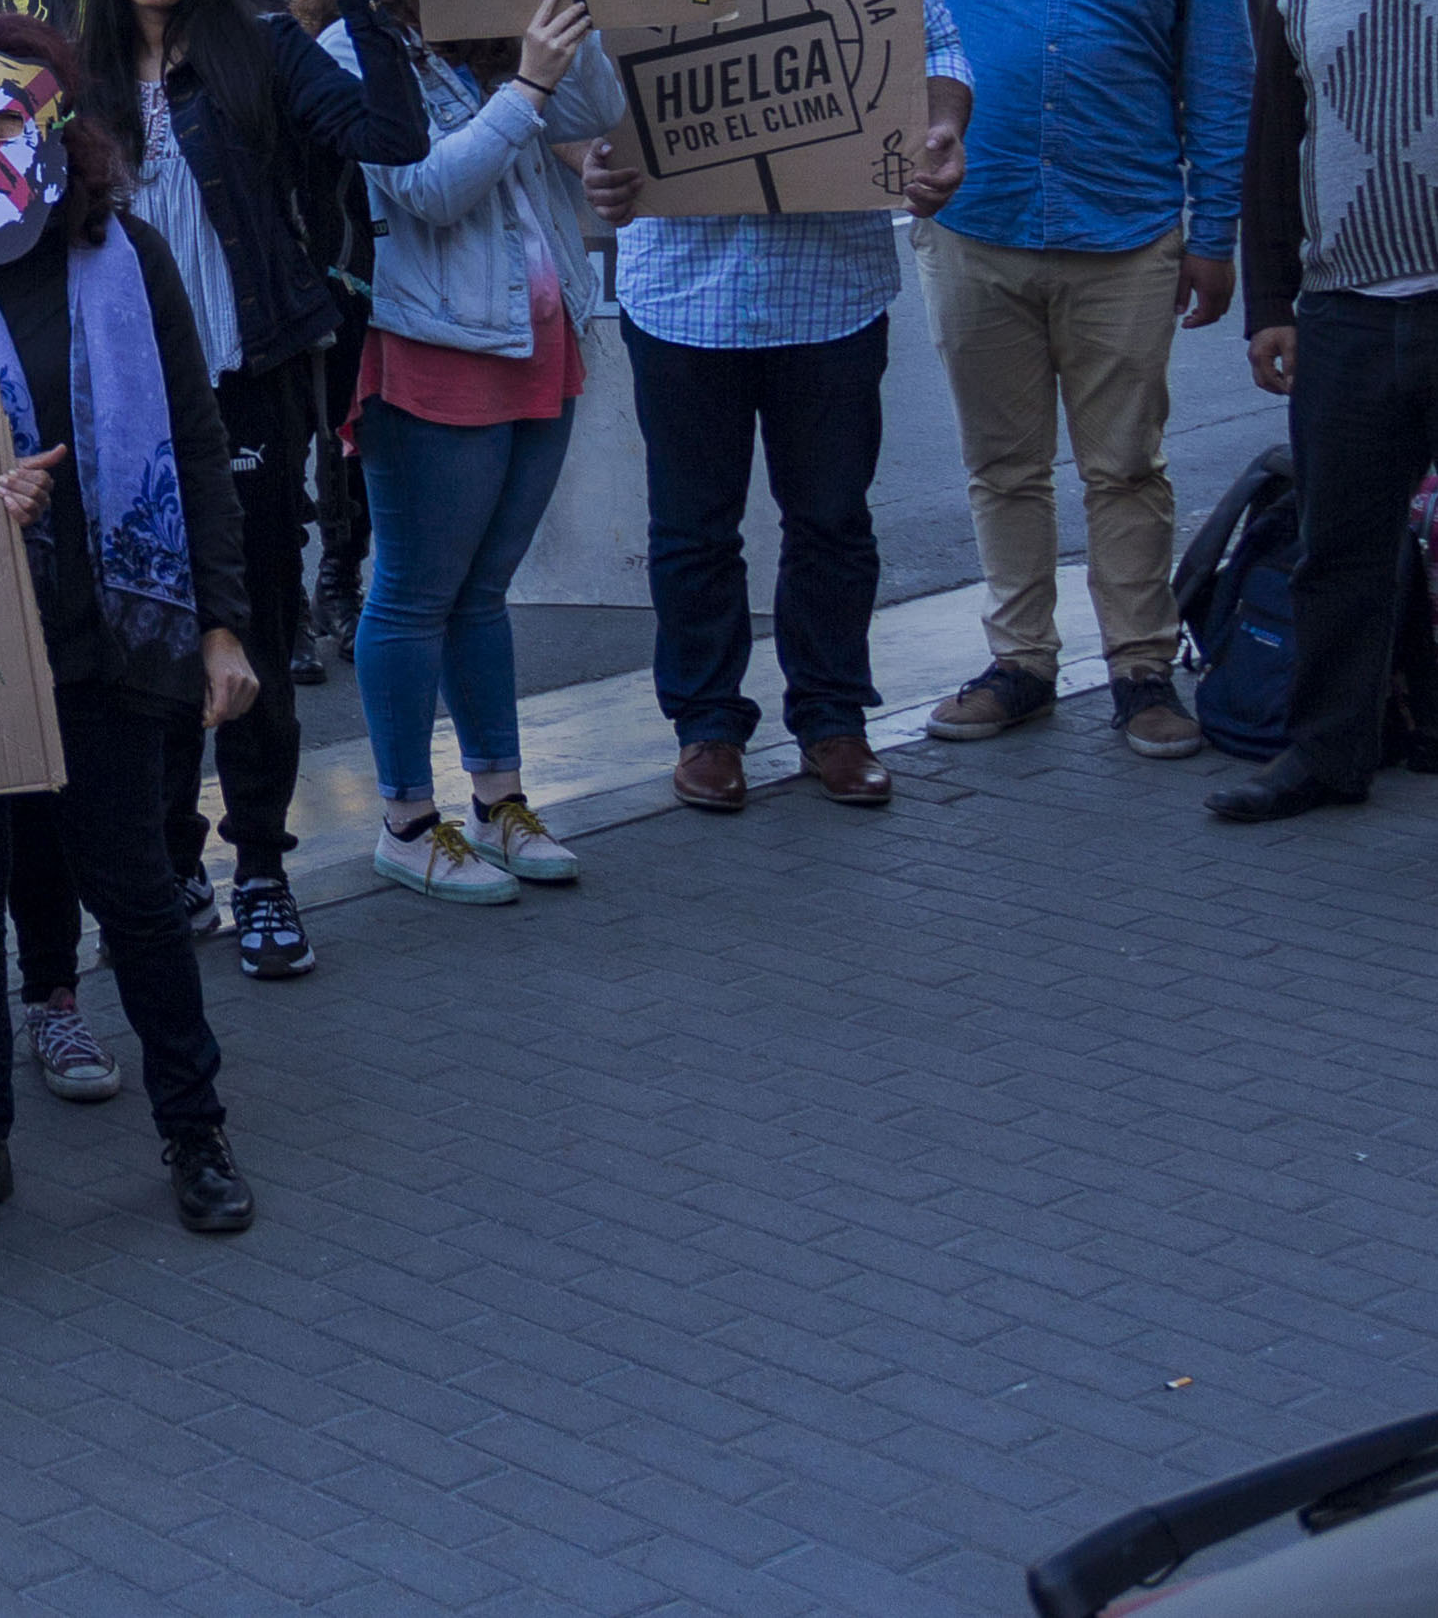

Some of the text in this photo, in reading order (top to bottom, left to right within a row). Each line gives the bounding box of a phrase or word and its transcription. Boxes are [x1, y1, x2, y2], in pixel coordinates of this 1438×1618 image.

[655, 38, 833, 123] HUELGA
[664, 92, 843, 156] POR EL CLIMA
